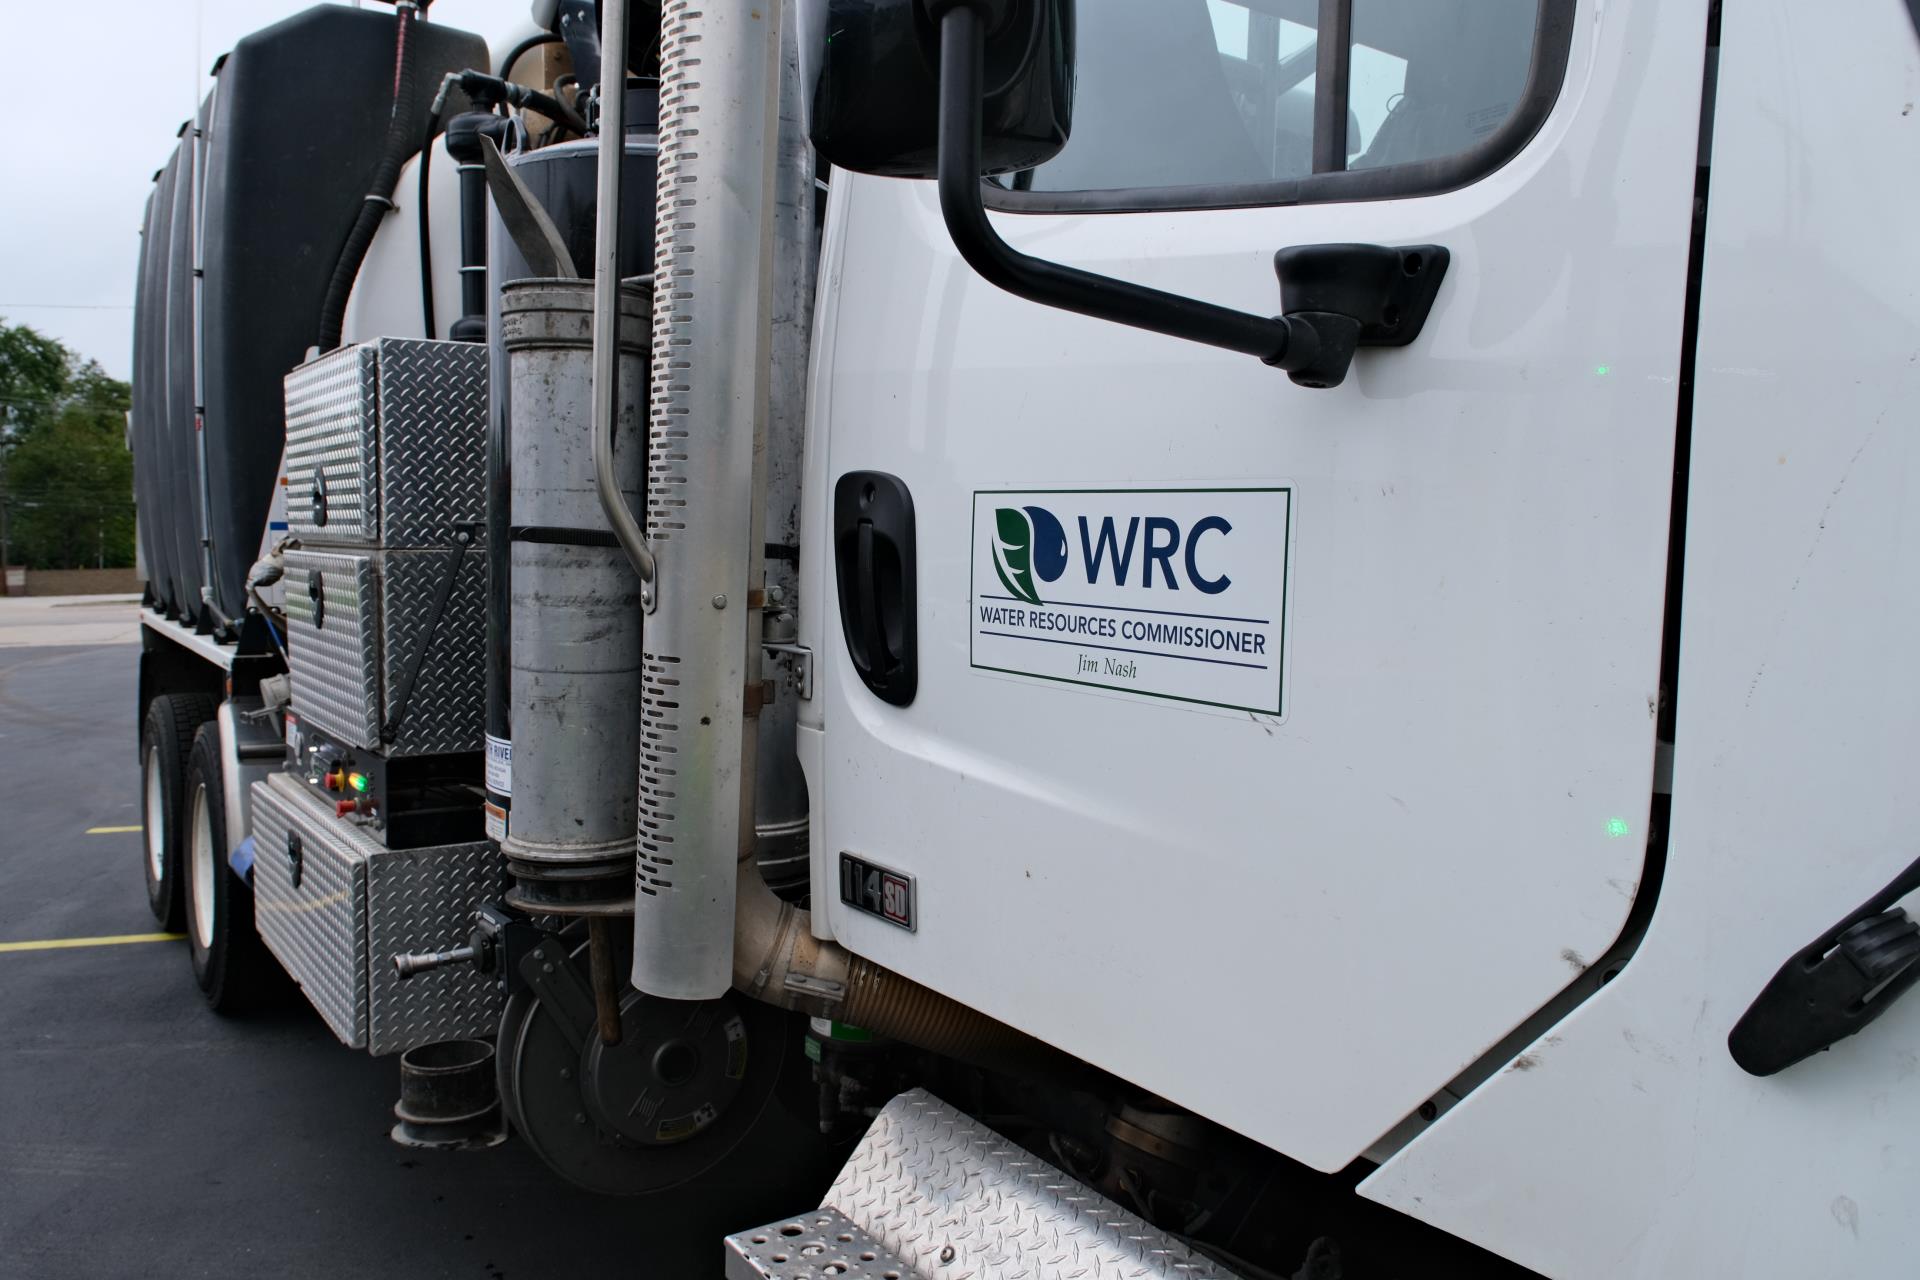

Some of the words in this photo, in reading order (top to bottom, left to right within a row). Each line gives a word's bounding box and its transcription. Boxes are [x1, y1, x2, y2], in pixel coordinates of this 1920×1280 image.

[1077, 515, 1233, 595] WRC
[979, 605, 1025, 627] WATER
[1029, 611, 1117, 637] RESOURCES
[1121, 620, 1266, 655] COMMISSIONER
[1077, 654, 1099, 675] Jim
[1103, 657, 1137, 679] Nash
